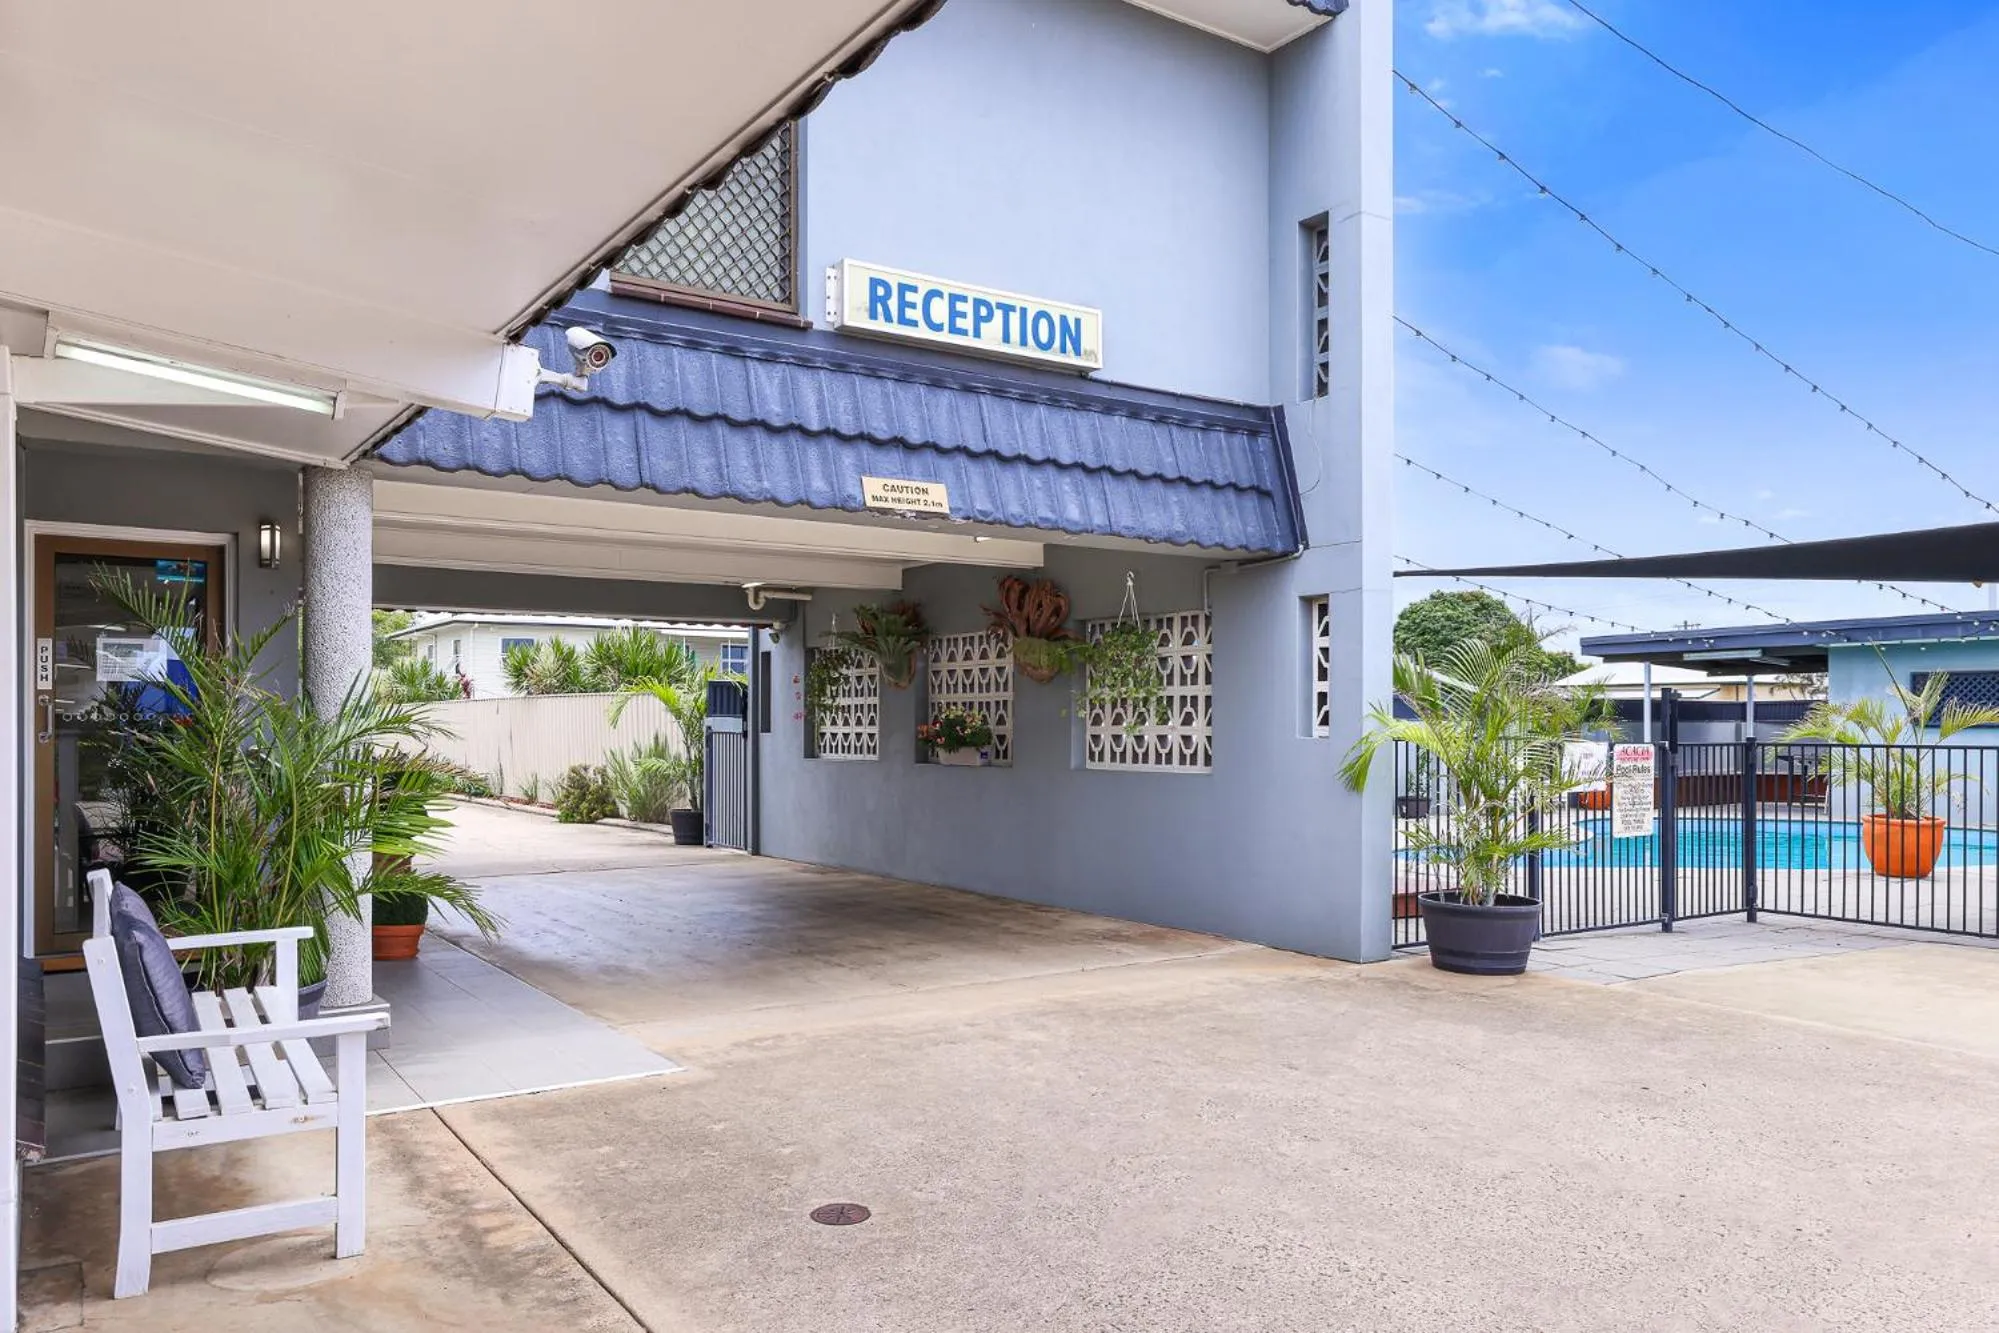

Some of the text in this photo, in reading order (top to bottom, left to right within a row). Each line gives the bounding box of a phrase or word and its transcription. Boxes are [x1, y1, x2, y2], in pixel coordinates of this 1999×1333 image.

[868, 276, 1082, 357] RECEPTION
[870, 494, 943, 508] MAX HEIGHT 2.1m
[882, 483, 930, 496] CAUTION
[40, 646, 49, 682] PUSH
